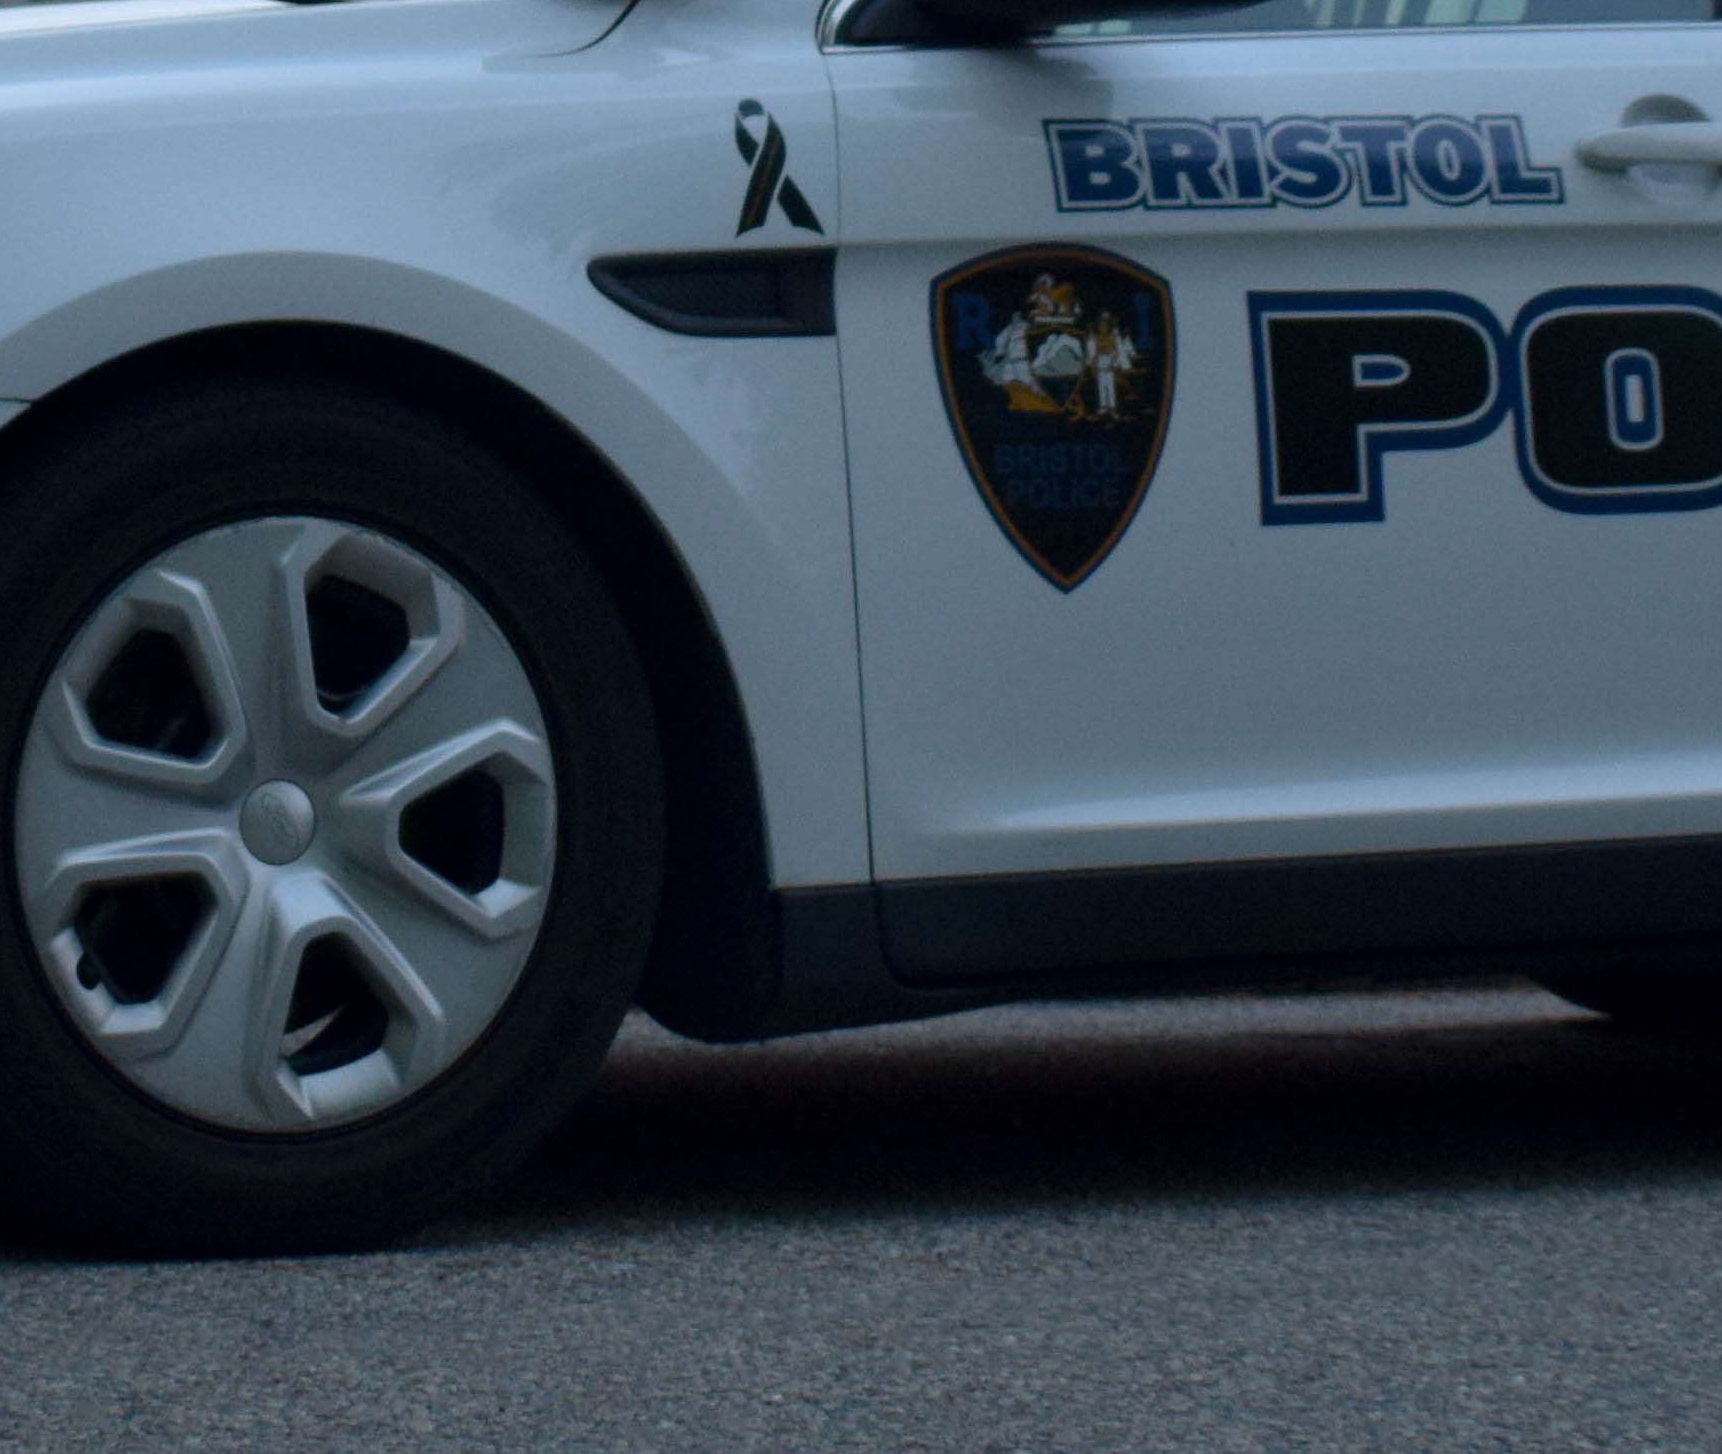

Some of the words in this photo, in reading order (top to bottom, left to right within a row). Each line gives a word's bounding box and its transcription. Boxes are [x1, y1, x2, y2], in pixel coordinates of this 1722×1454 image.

[1042, 115, 1565, 212] BRISTOL
[992, 443, 1130, 475] BRISTOL
[1006, 478, 1120, 508] POLICE
